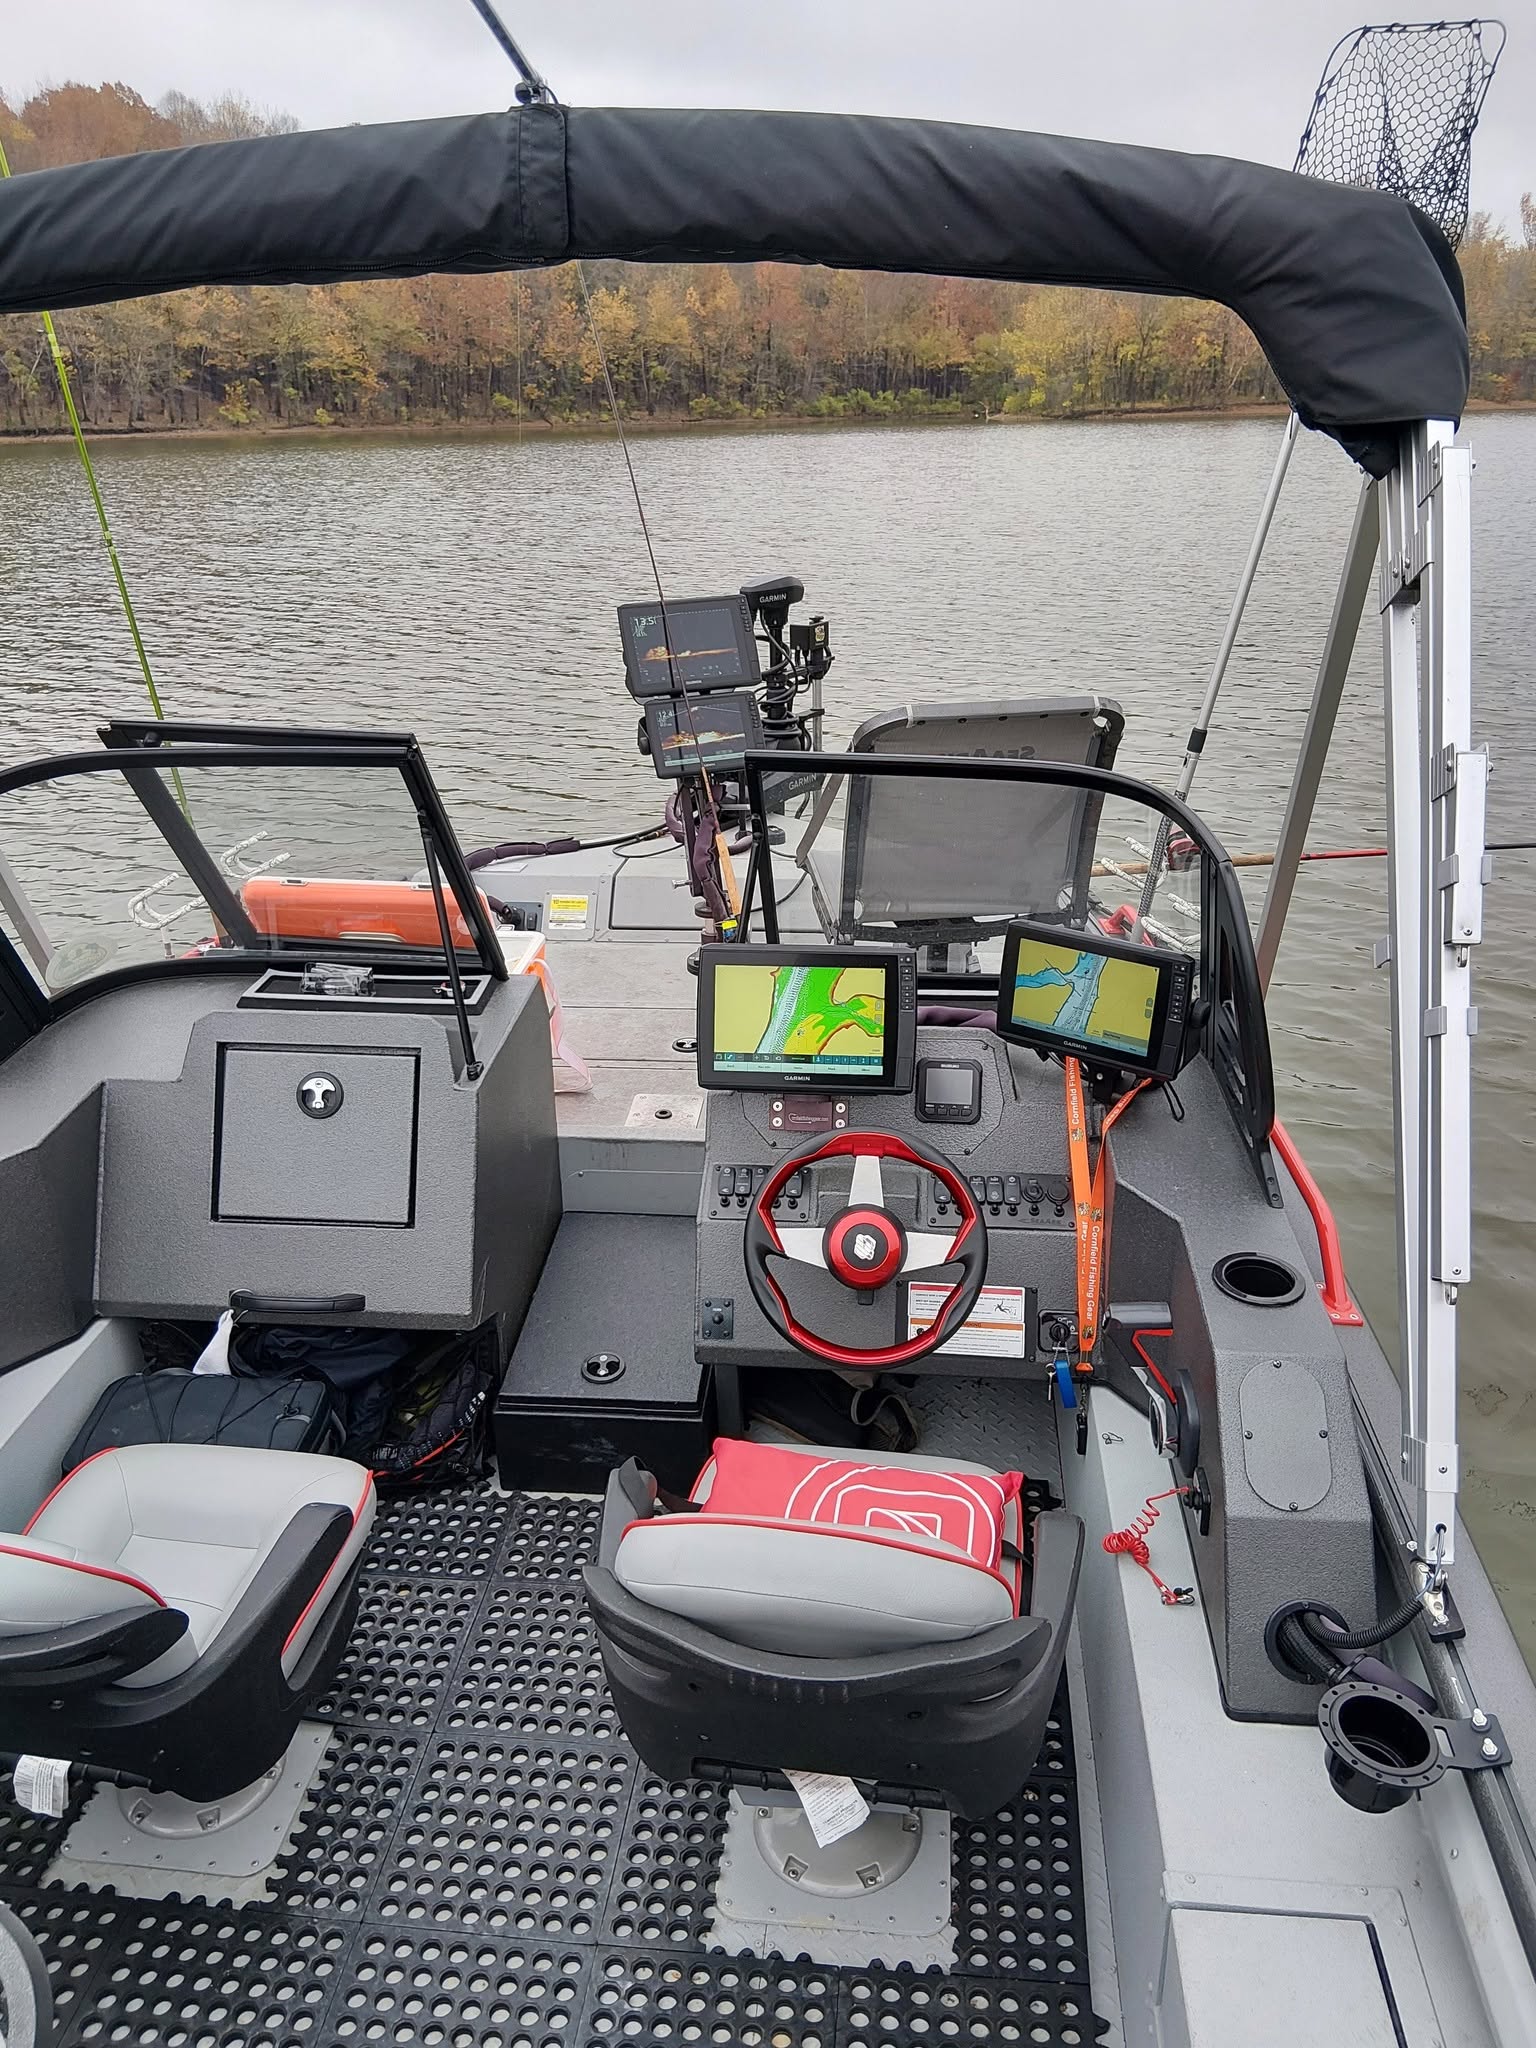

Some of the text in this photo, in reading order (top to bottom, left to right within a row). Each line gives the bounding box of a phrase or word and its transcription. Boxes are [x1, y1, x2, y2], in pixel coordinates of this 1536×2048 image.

[759, 593, 787, 604] GARMIN
[788, 772, 817, 791] GARMIN
[1063, 1040, 1088, 1051] GARMIN
[1069, 1057, 1080, 1125] Cornfield Fishing
[1086, 1225, 1100, 1321] Cornfield Fishing Gear
